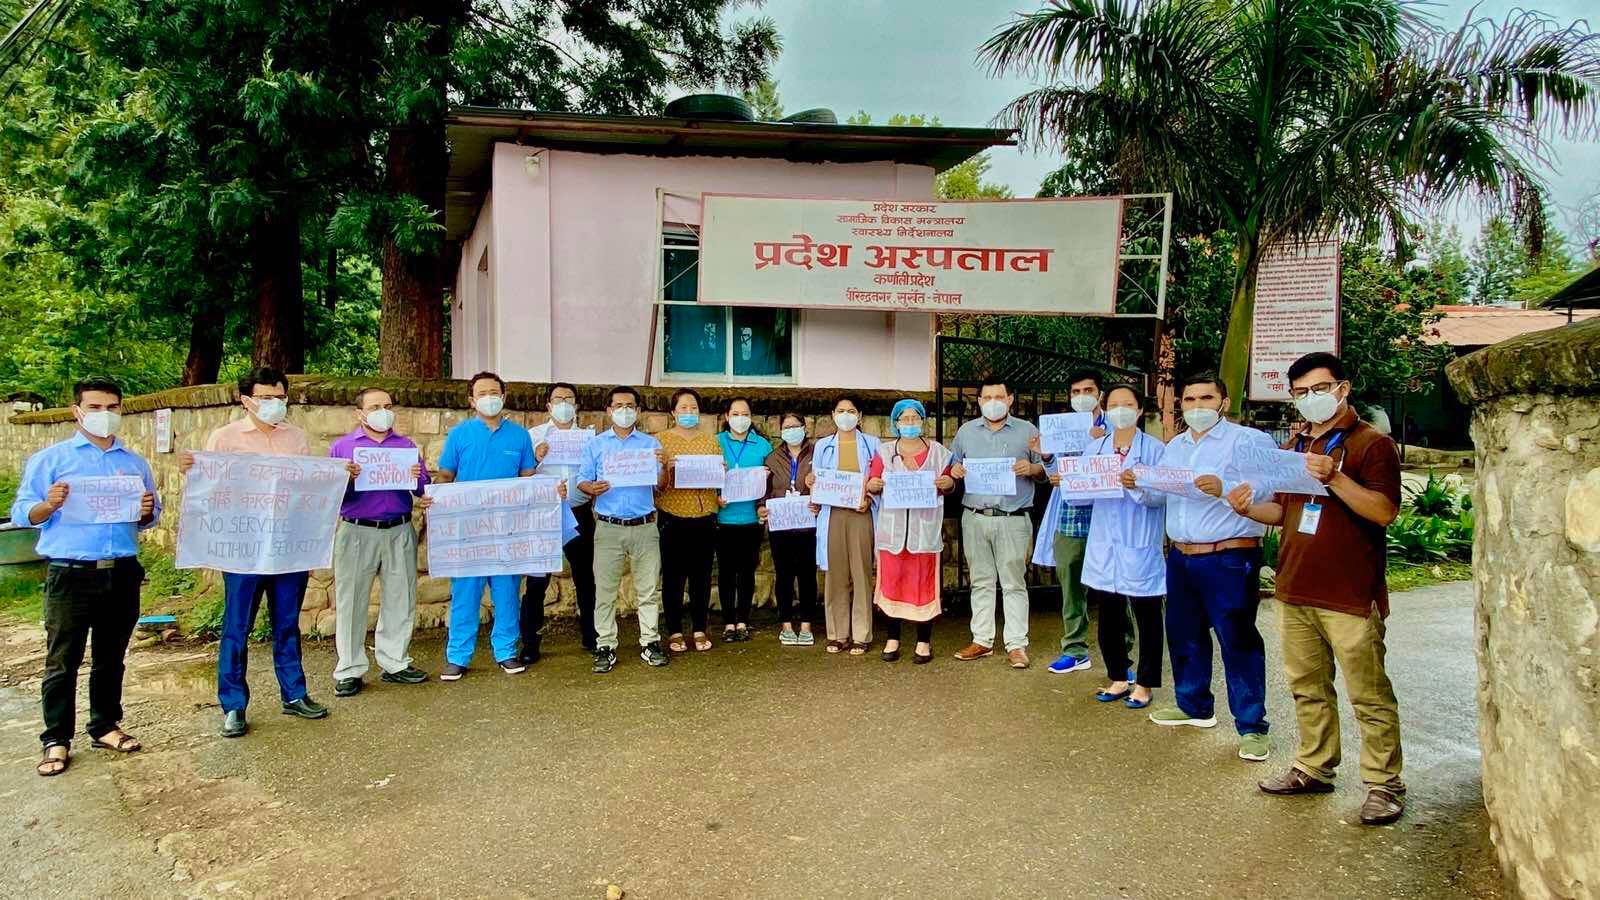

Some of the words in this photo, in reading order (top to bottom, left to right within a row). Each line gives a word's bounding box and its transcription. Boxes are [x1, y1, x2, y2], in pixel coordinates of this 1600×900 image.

[873, 202, 898, 214] प्रदेश
[900, 203, 938, 214] सरकार
[880, 214, 912, 225] विकास
[753, 235, 852, 270] प्रदेश
[863, 245, 1055, 273] अस्पताल
[909, 272, 936, 287] प्रदेश
[932, 289, 962, 304] नेपाल
[200, 512, 224, 535] NO
[207, 539, 264, 560] WITHOUT
